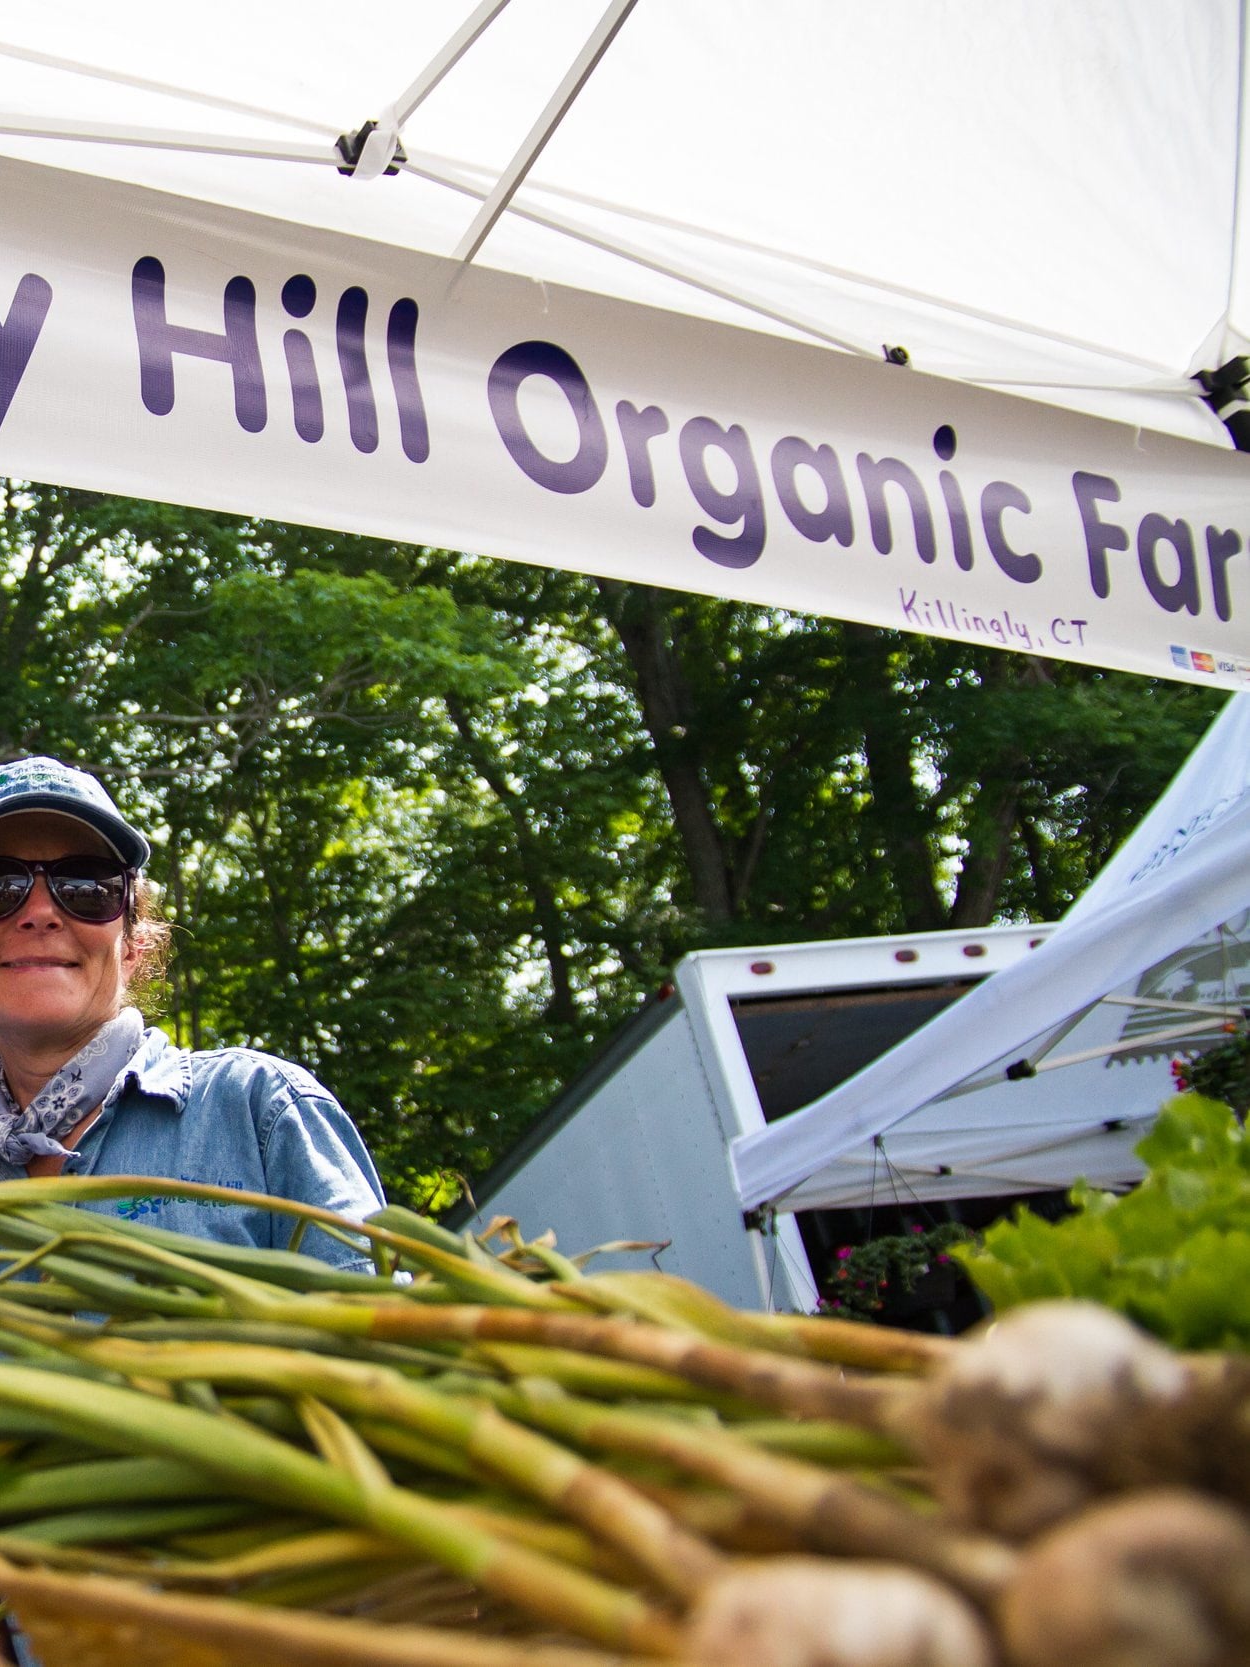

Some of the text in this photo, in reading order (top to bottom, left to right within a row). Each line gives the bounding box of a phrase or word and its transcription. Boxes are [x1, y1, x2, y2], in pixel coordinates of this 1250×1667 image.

[131, 255, 430, 464] Hill
[487, 339, 1043, 584] Organic
[1072, 470, 1250, 623] Far
[899, 587, 1088, 649] Killingly, CT
